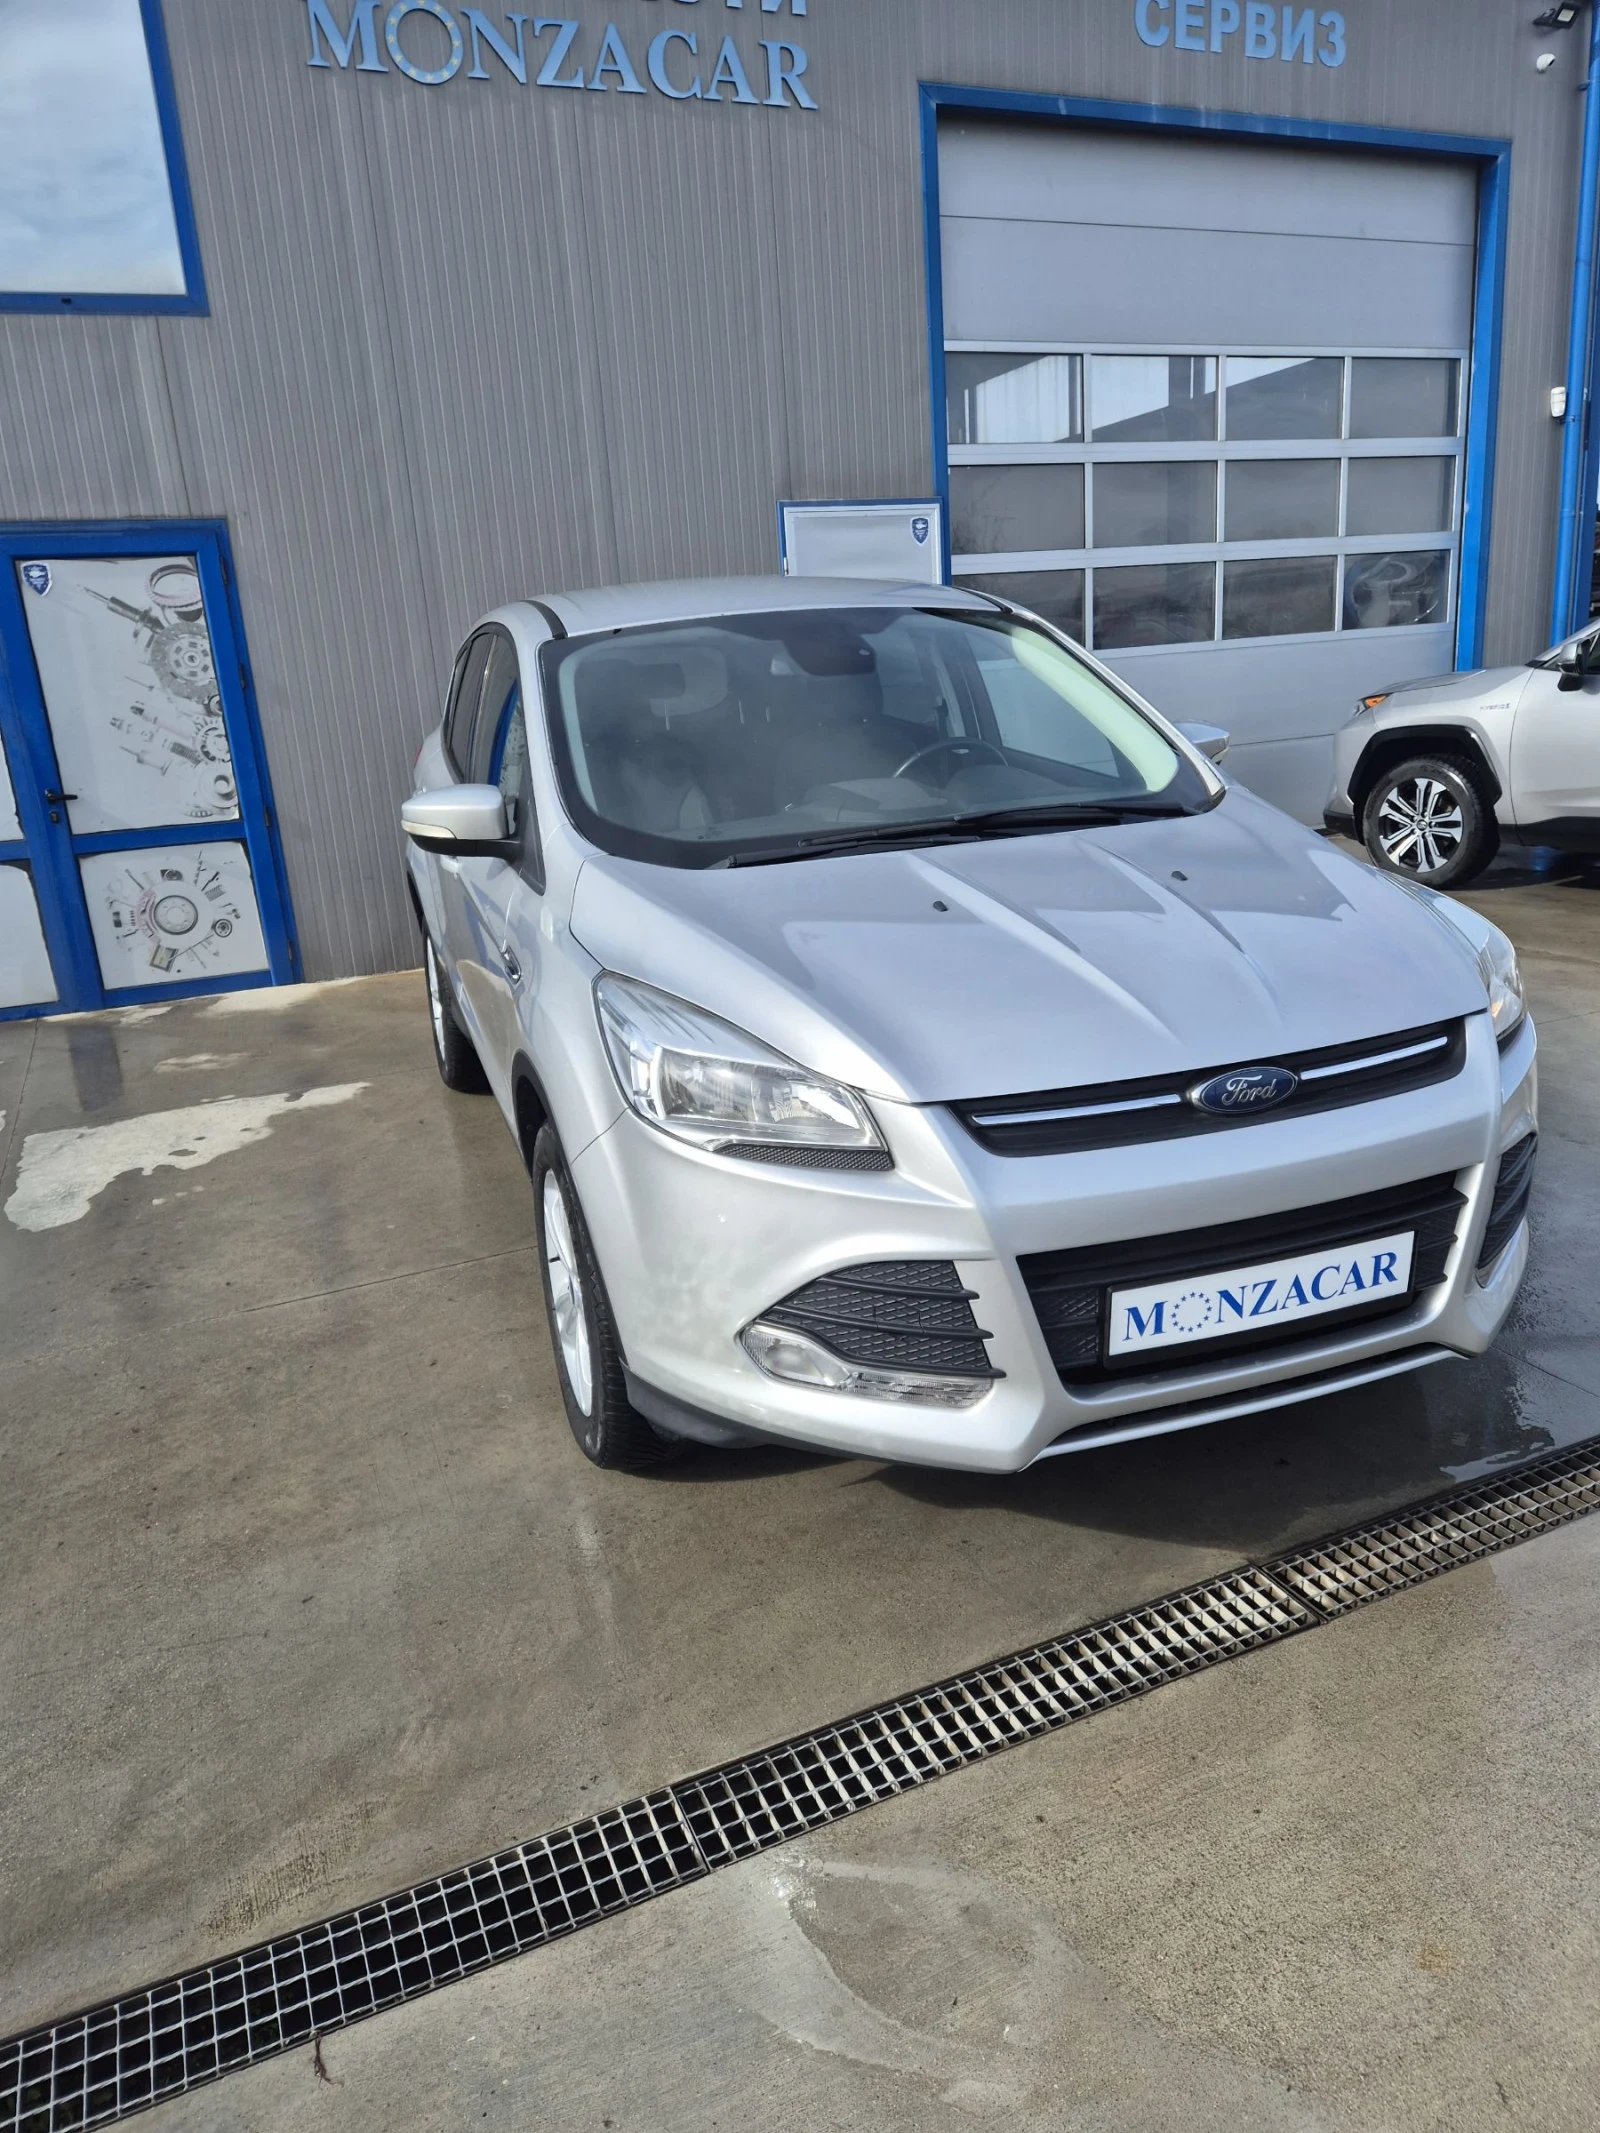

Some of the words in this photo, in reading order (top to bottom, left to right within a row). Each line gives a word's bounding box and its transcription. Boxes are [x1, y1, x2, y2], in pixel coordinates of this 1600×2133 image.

[306, 0, 818, 110] MONZACAR
[1134, 0, 1347, 68] СЕРВИЗ
[1221, 1074, 1277, 1106] Ford
[1122, 1251, 1398, 1341] MONZACAR
